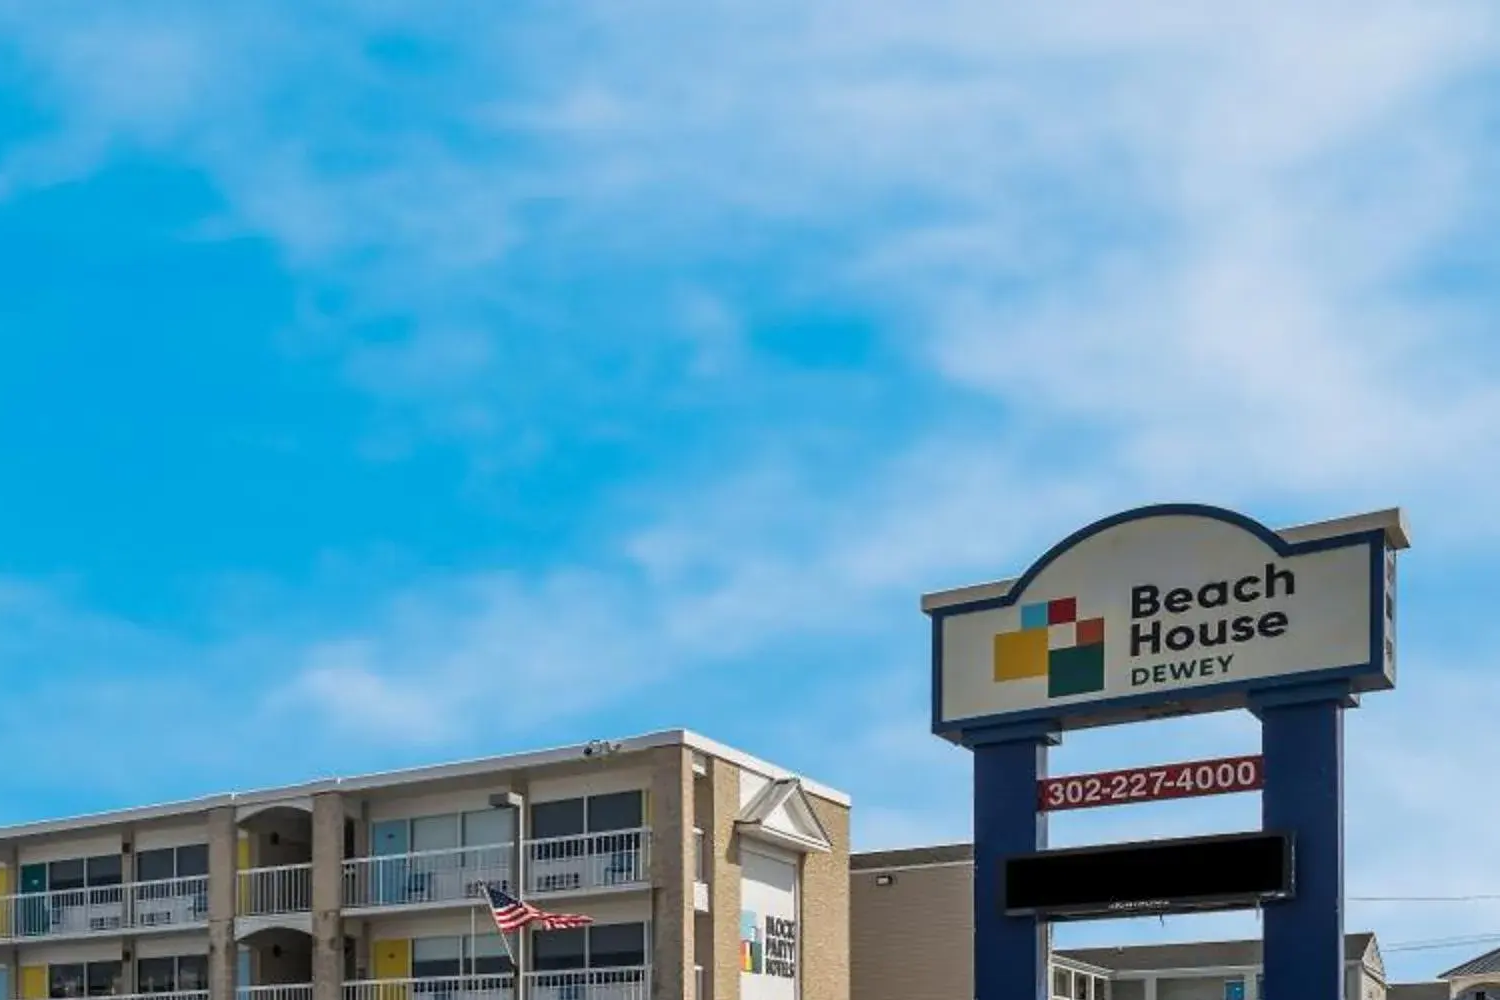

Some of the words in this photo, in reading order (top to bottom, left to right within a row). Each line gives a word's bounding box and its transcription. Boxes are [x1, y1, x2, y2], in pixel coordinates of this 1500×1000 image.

[1131, 563, 1295, 619] Beach
[1130, 611, 1289, 657] House
[1131, 653, 1235, 686] DEWEY
[1049, 761, 1256, 805] 302-227-4000
[765, 937, 795, 961] PARTY
